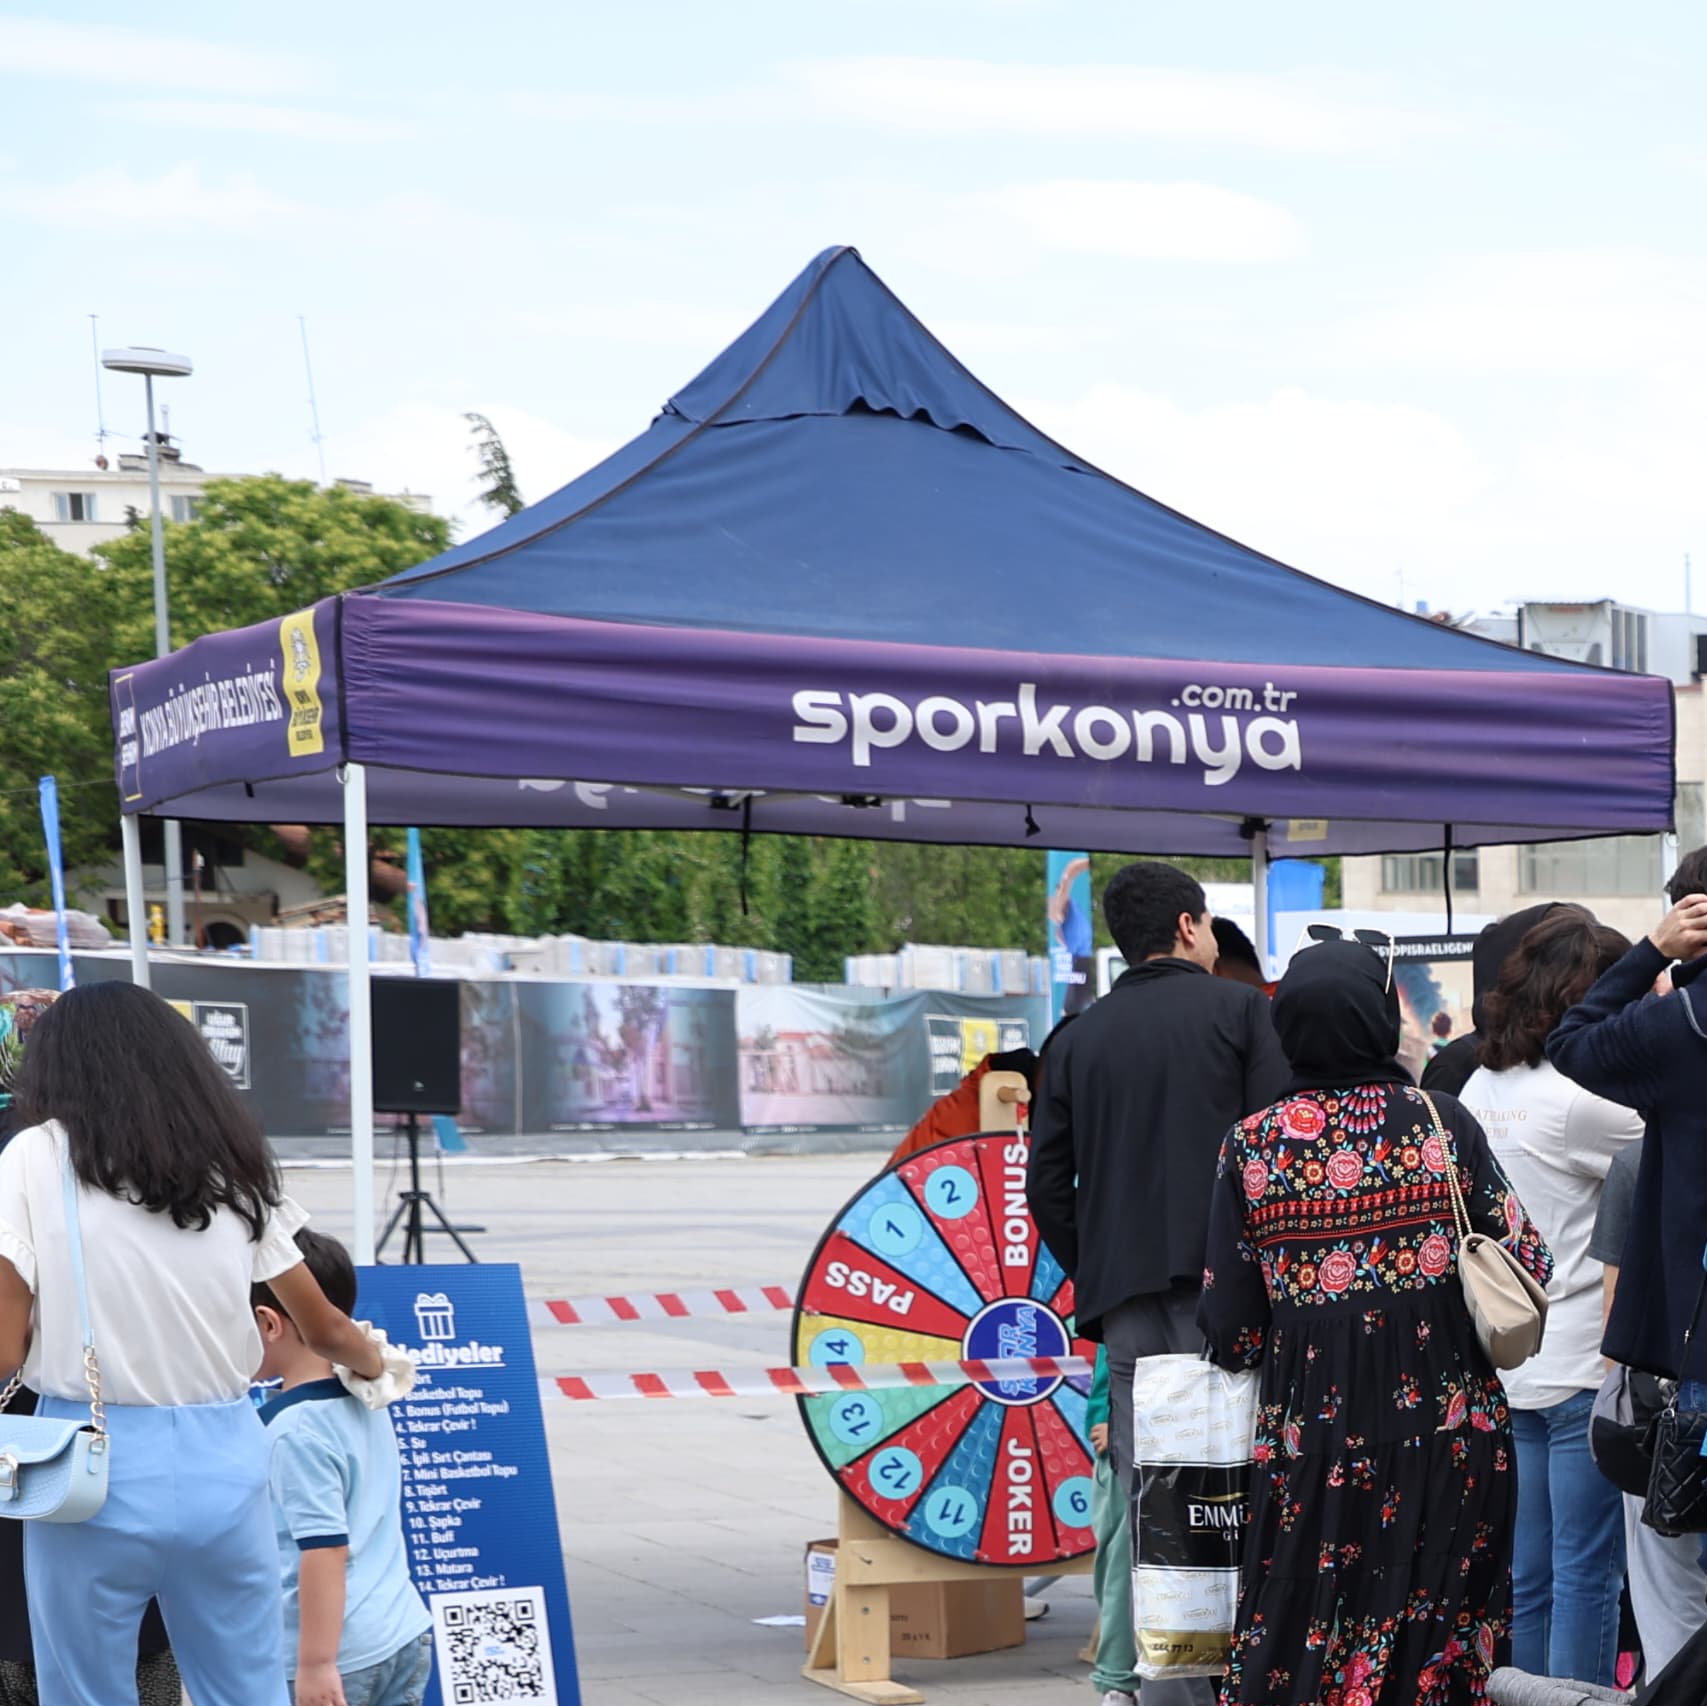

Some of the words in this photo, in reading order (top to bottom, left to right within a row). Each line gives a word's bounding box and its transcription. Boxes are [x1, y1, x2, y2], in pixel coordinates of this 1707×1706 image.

[791, 683, 1302, 786] sporkonya
[941, 1179, 961, 1204] 2
[1004, 1143, 1029, 1266] BONUS
[885, 1220, 905, 1239] 1
[825, 1262, 915, 1315] PASS
[406, 1405, 441, 1417] Bonus
[841, 1403, 871, 1436] 13
[411, 1437, 427, 1449] Su
[414, 1468, 439, 1480] Mini
[493, 1464, 519, 1478] Topu
[880, 1457, 911, 1489] 12
[939, 1498, 966, 1526] 11
[1007, 1438, 1032, 1556] JOKER
